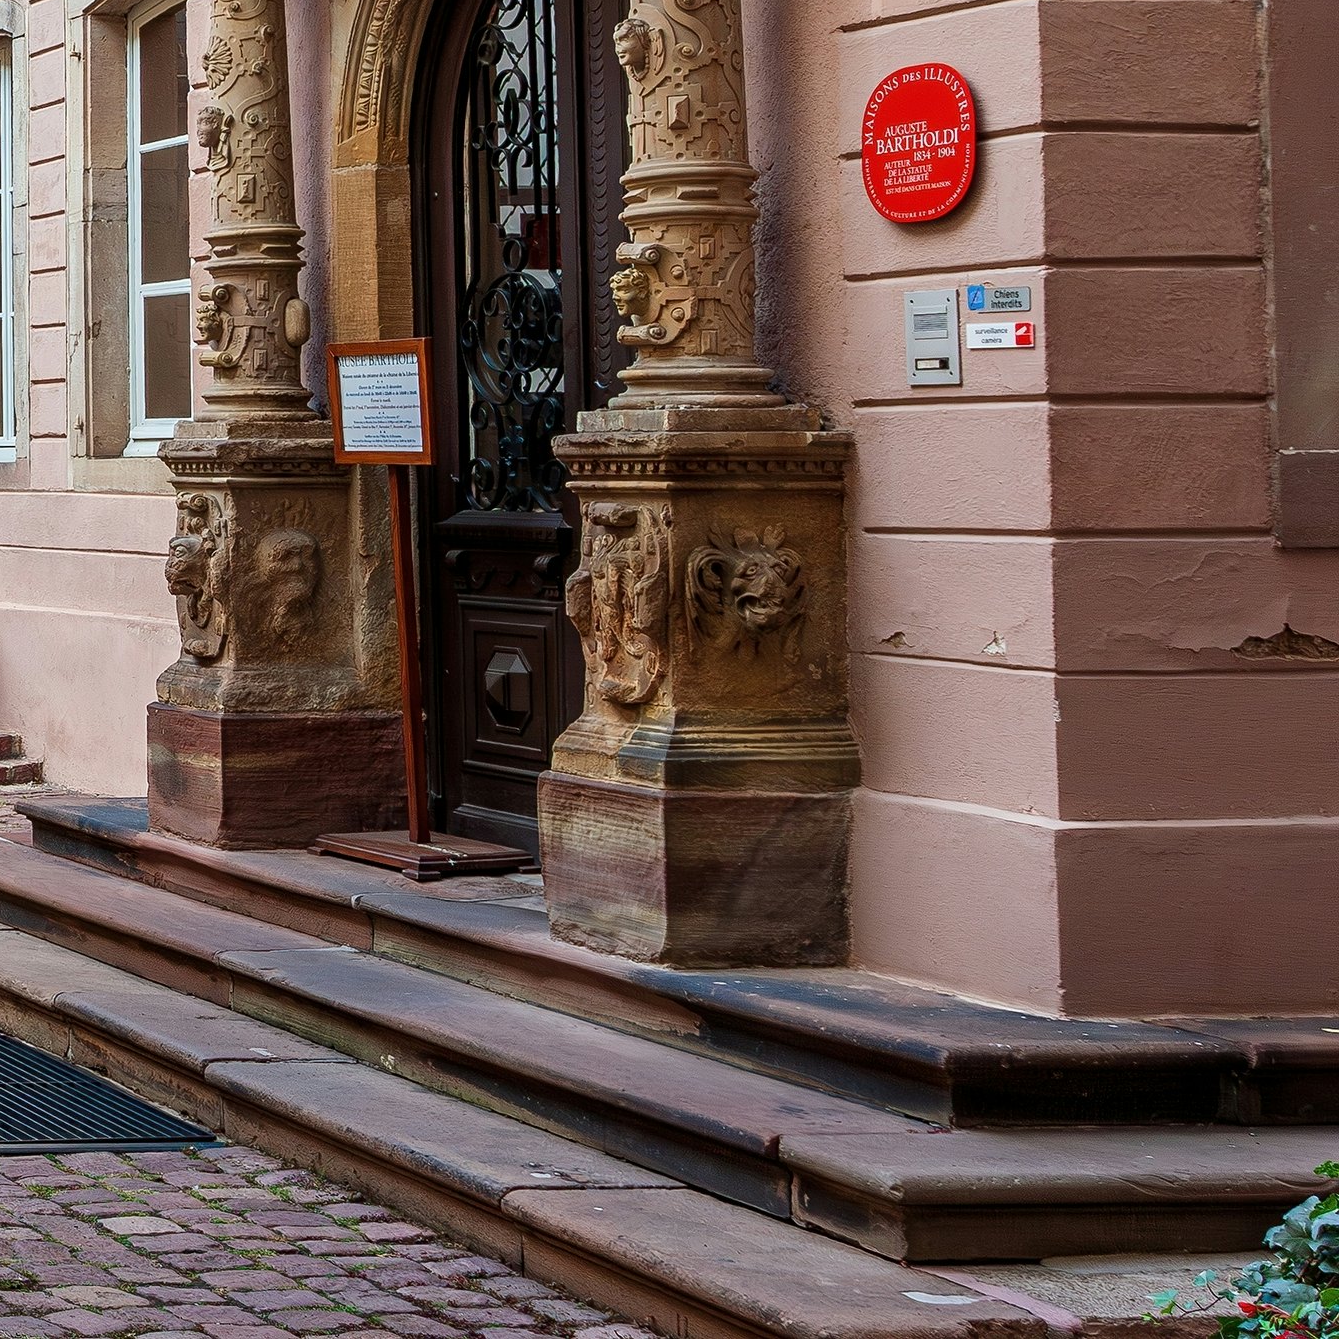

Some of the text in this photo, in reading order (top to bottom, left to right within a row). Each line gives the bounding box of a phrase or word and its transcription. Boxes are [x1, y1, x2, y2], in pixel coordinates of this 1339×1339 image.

[865, 67, 971, 145] MAISONS DES ILLUSTRES
[885, 121, 927, 137] AUGUSTE
[876, 127, 959, 155] BARTHOLDI
[913, 148, 931, 162] 1834
[937, 145, 956, 158] 1904
[884, 159, 911, 170] AUTEUR
[888, 164, 933, 178] DE LA STATUE
[884, 172, 929, 187] DE LA LIBERTÉ
[994, 290, 1019, 298] Chiens
[991, 299, 1022, 308] interdits
[975, 327, 1008, 335] surveillance
